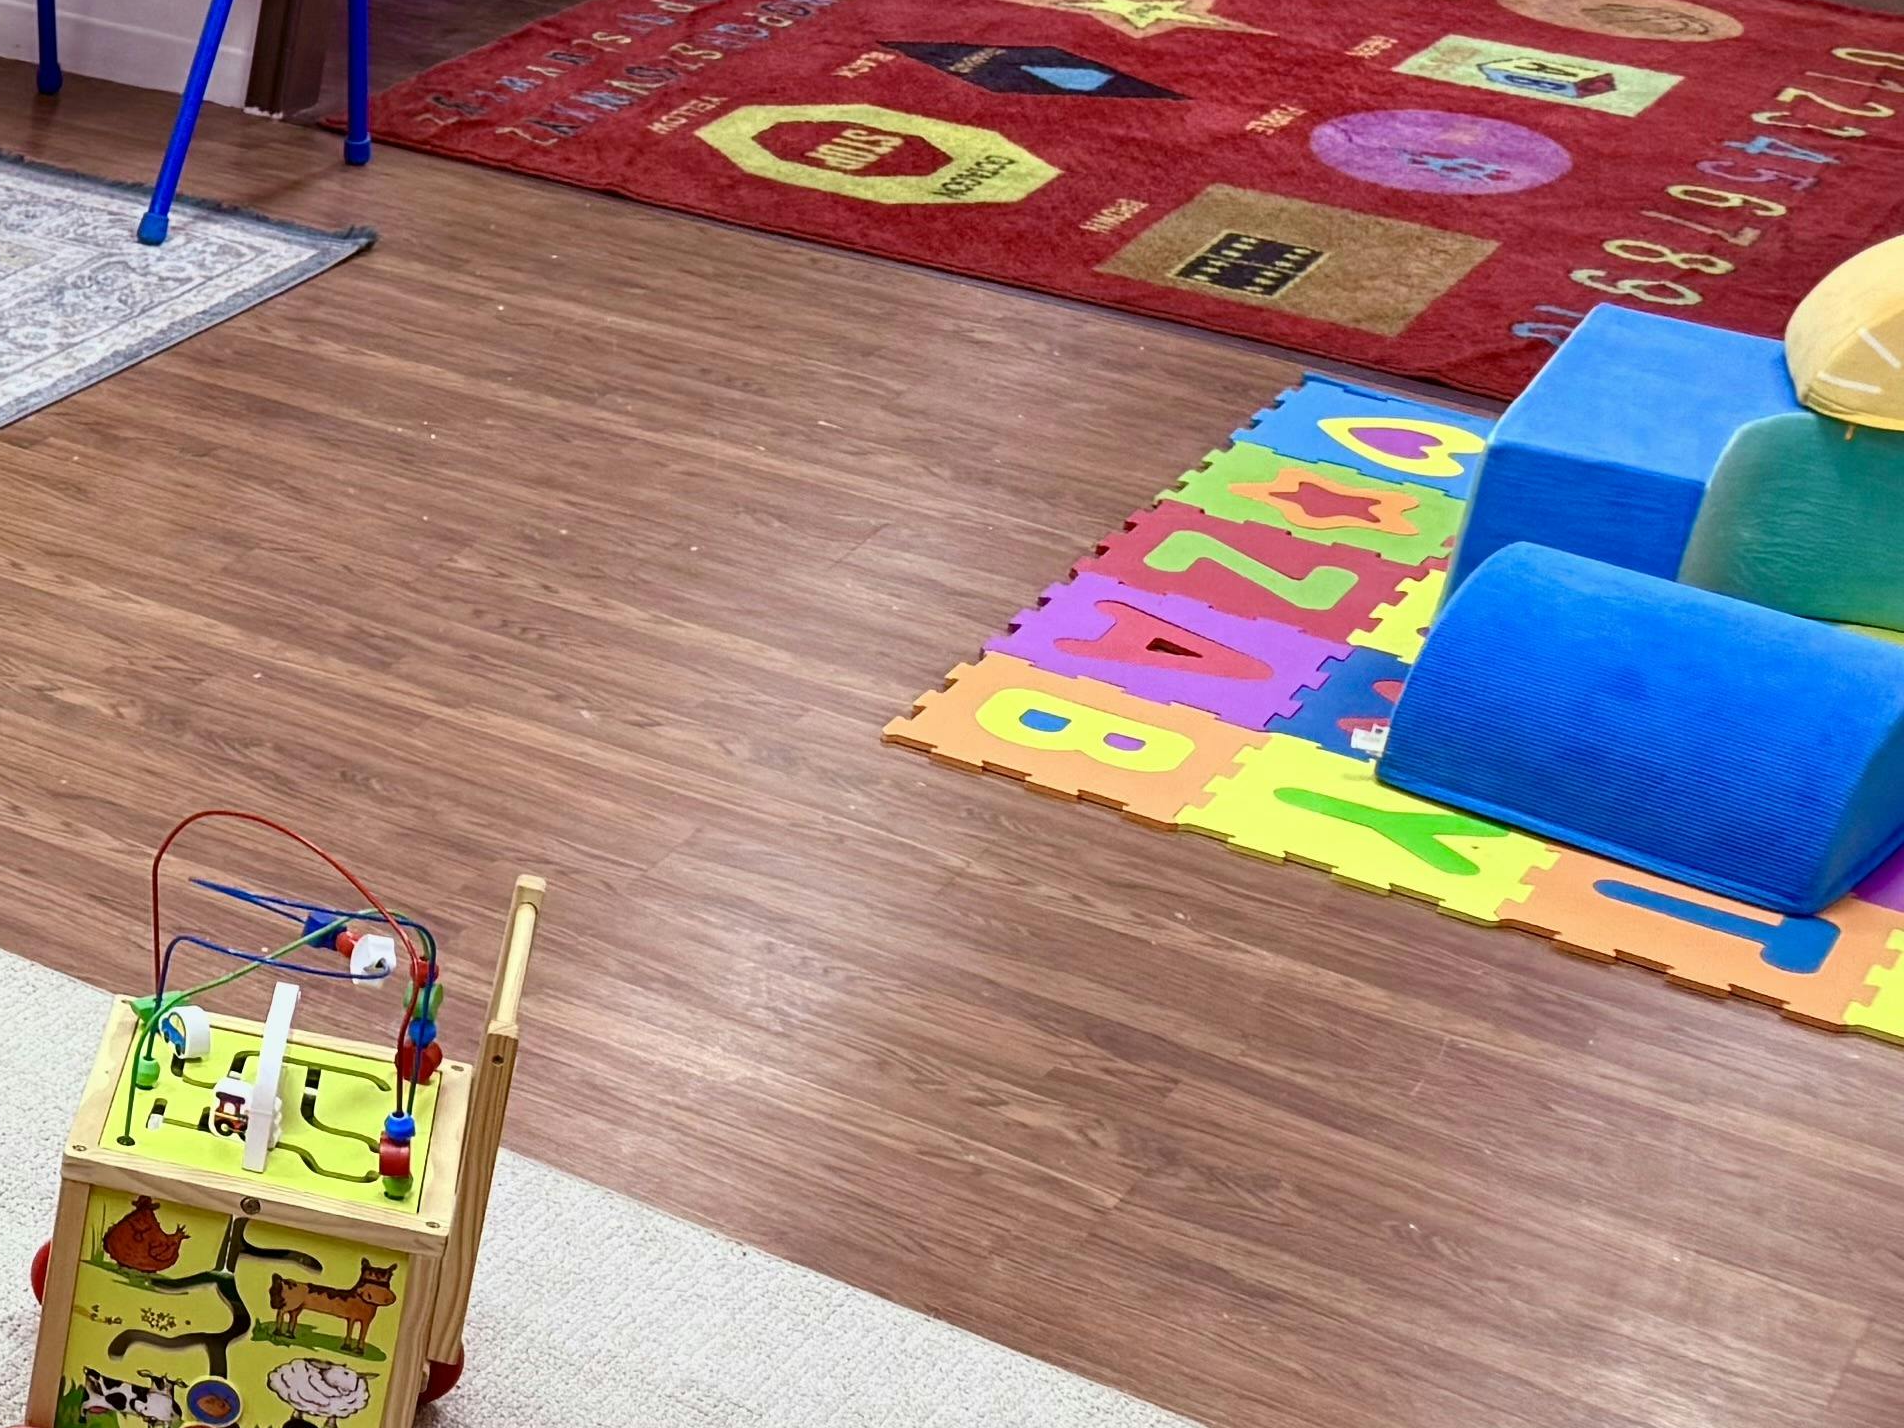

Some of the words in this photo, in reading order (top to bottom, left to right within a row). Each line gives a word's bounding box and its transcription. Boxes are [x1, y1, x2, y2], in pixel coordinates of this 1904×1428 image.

[647, 94, 731, 135] YELLOW
[1776, 86, 1895, 118] 2
[1751, 110, 1866, 139] 3
[804, 127, 905, 171] STOP
[1724, 136, 1842, 165] 4
[929, 154, 1018, 200] OCTAGON
[1695, 160, 1820, 191] 5
[1664, 184, 1788, 217] 6
[1640, 209, 1762, 248] 7
[1602, 238, 1735, 276] 8
[1568, 268, 1703, 307] 9
[1054, 600, 1276, 681] A
[976, 686, 1194, 774] B
[1273, 786, 1511, 877] Y
